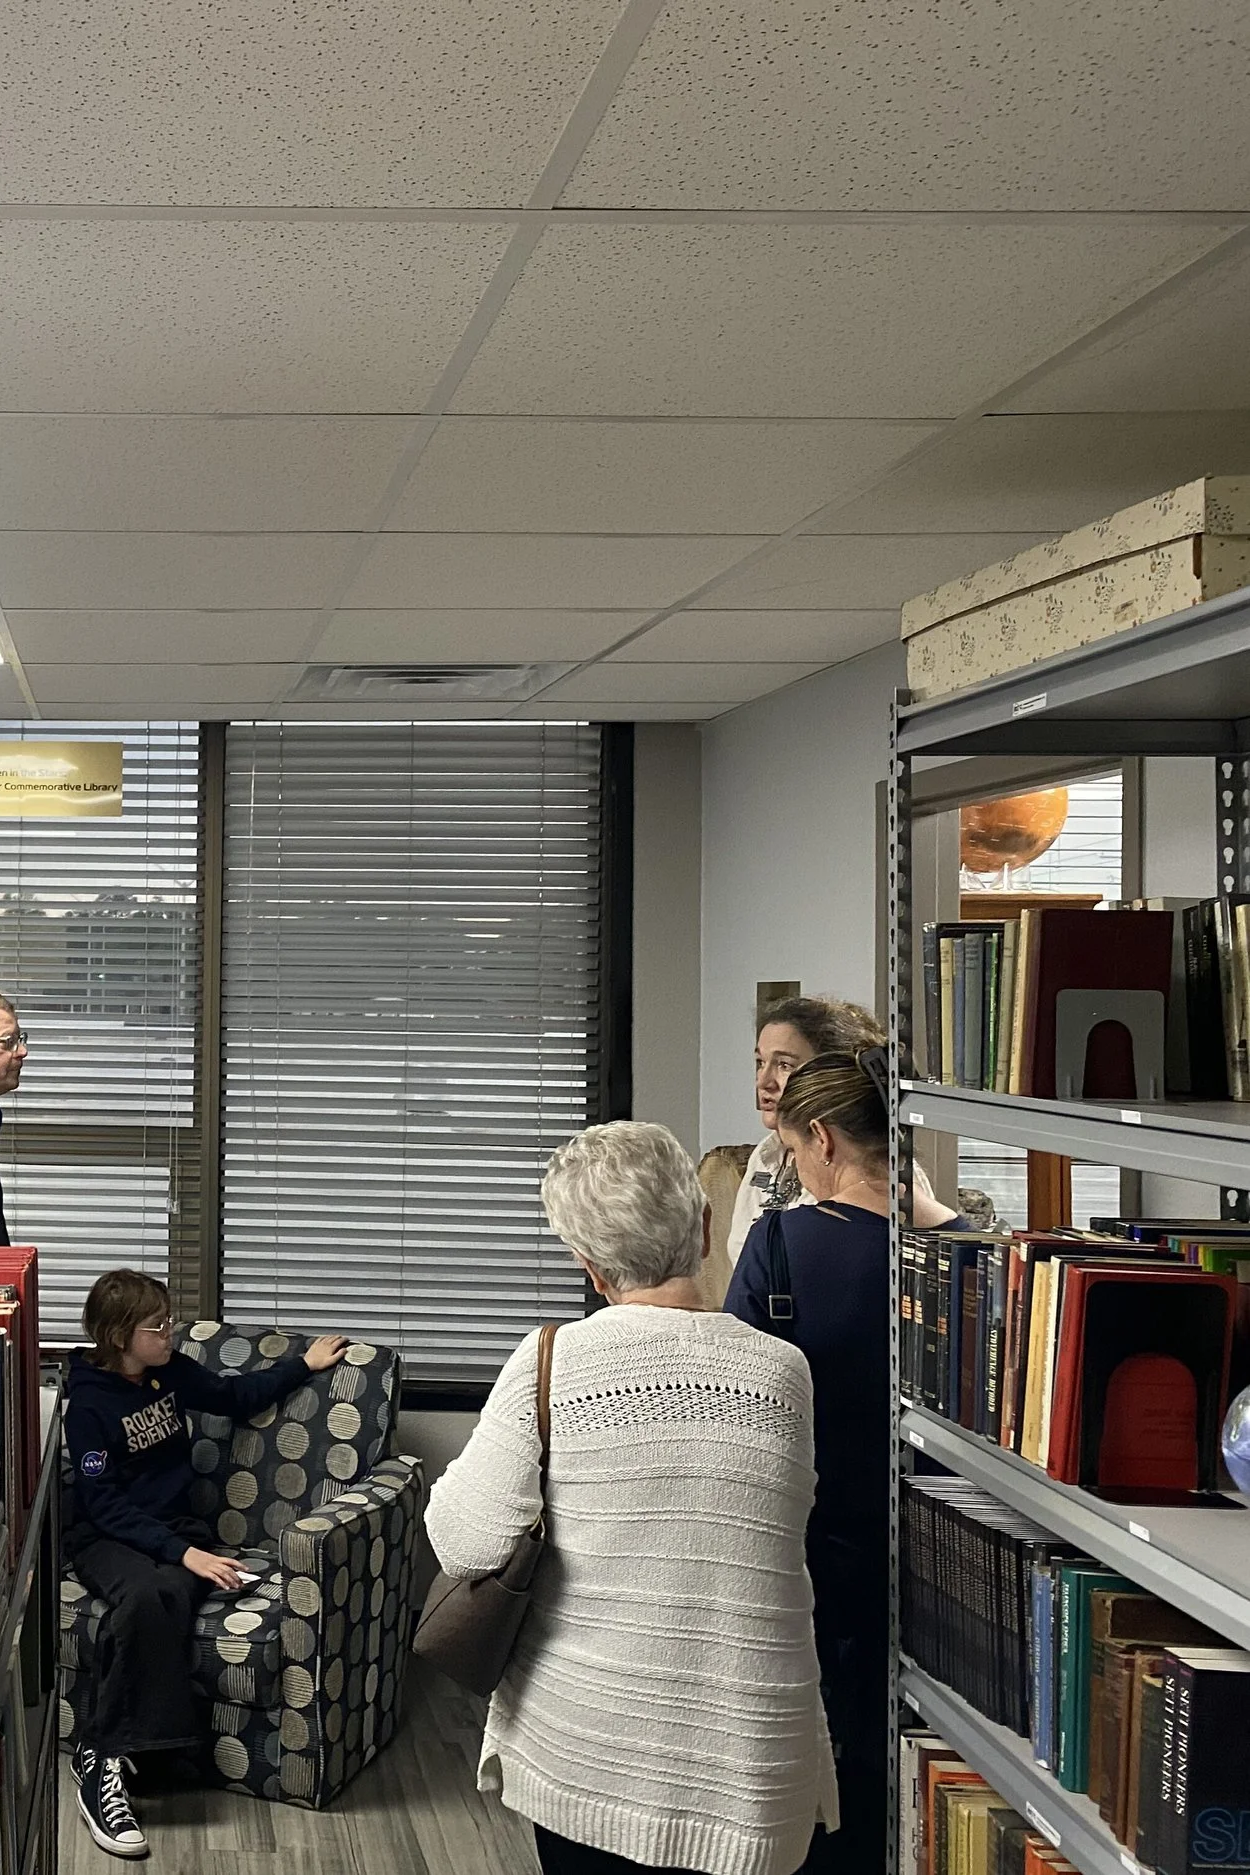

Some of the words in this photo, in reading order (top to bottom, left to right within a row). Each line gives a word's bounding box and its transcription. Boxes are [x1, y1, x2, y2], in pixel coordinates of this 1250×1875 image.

[4, 782, 81, 791] Commemorative
[83, 783, 118, 792] Library
[10, 768, 18, 777] in
[20, 768, 36, 777] the
[121, 1391, 176, 1437] ROCKET
[85, 1460, 102, 1468] NASA
[1164, 1674, 1175, 1714] SETI
[1178, 1687, 1190, 1727] SETI
[1161, 1718, 1174, 1802] PIONEERS
[1175, 1732, 1188, 1816] PIONEERS
